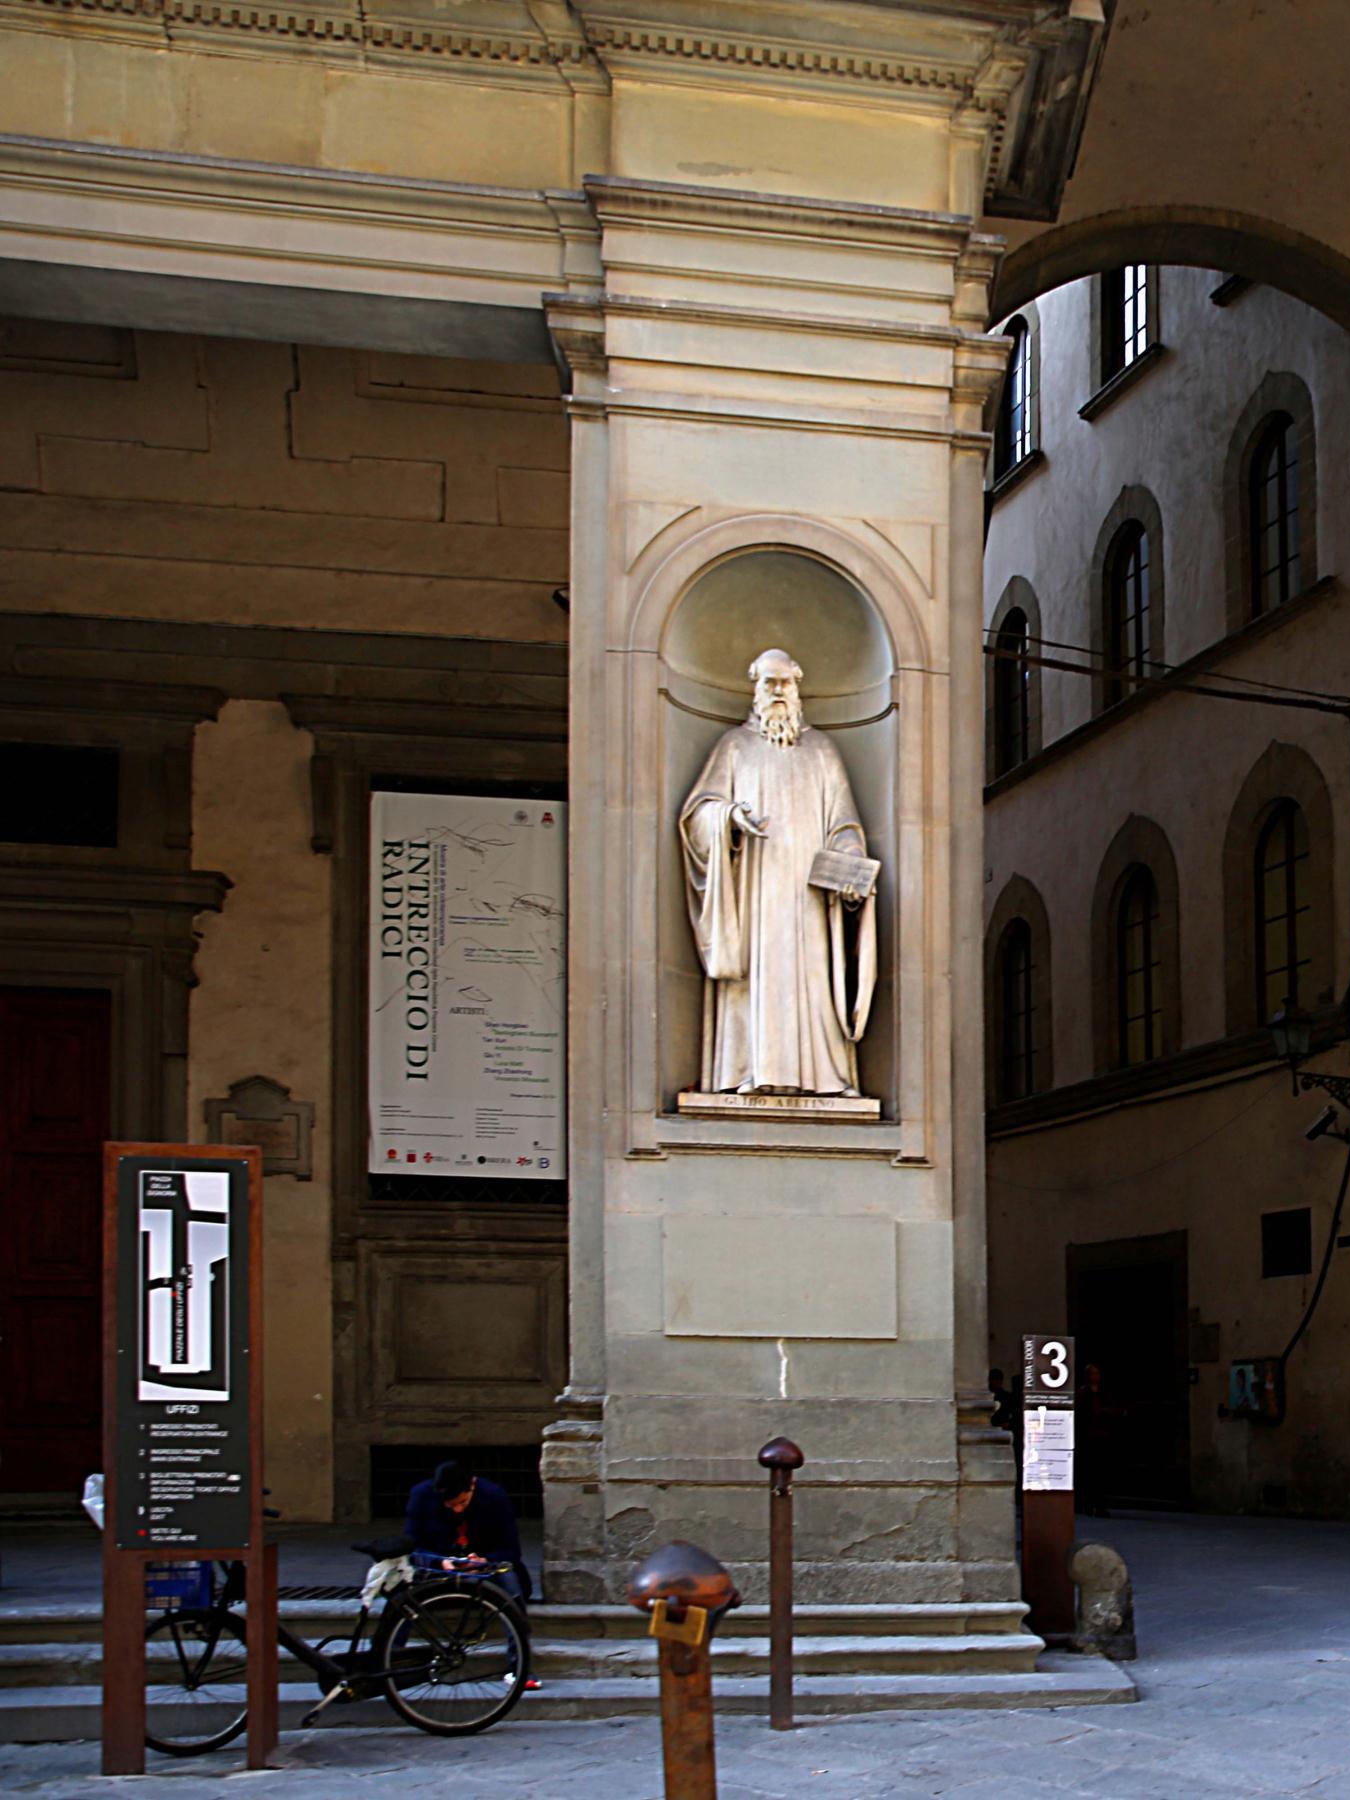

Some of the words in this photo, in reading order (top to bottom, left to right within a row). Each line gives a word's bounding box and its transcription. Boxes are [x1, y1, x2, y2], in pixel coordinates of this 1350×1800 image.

[381, 841, 404, 958] RADICI
[406, 841, 430, 1031] INTRECCIO
[406, 1044, 429, 1080] DI
[1040, 1341, 1069, 1388] 3
[166, 1404, 200, 1414] UFFIZI
